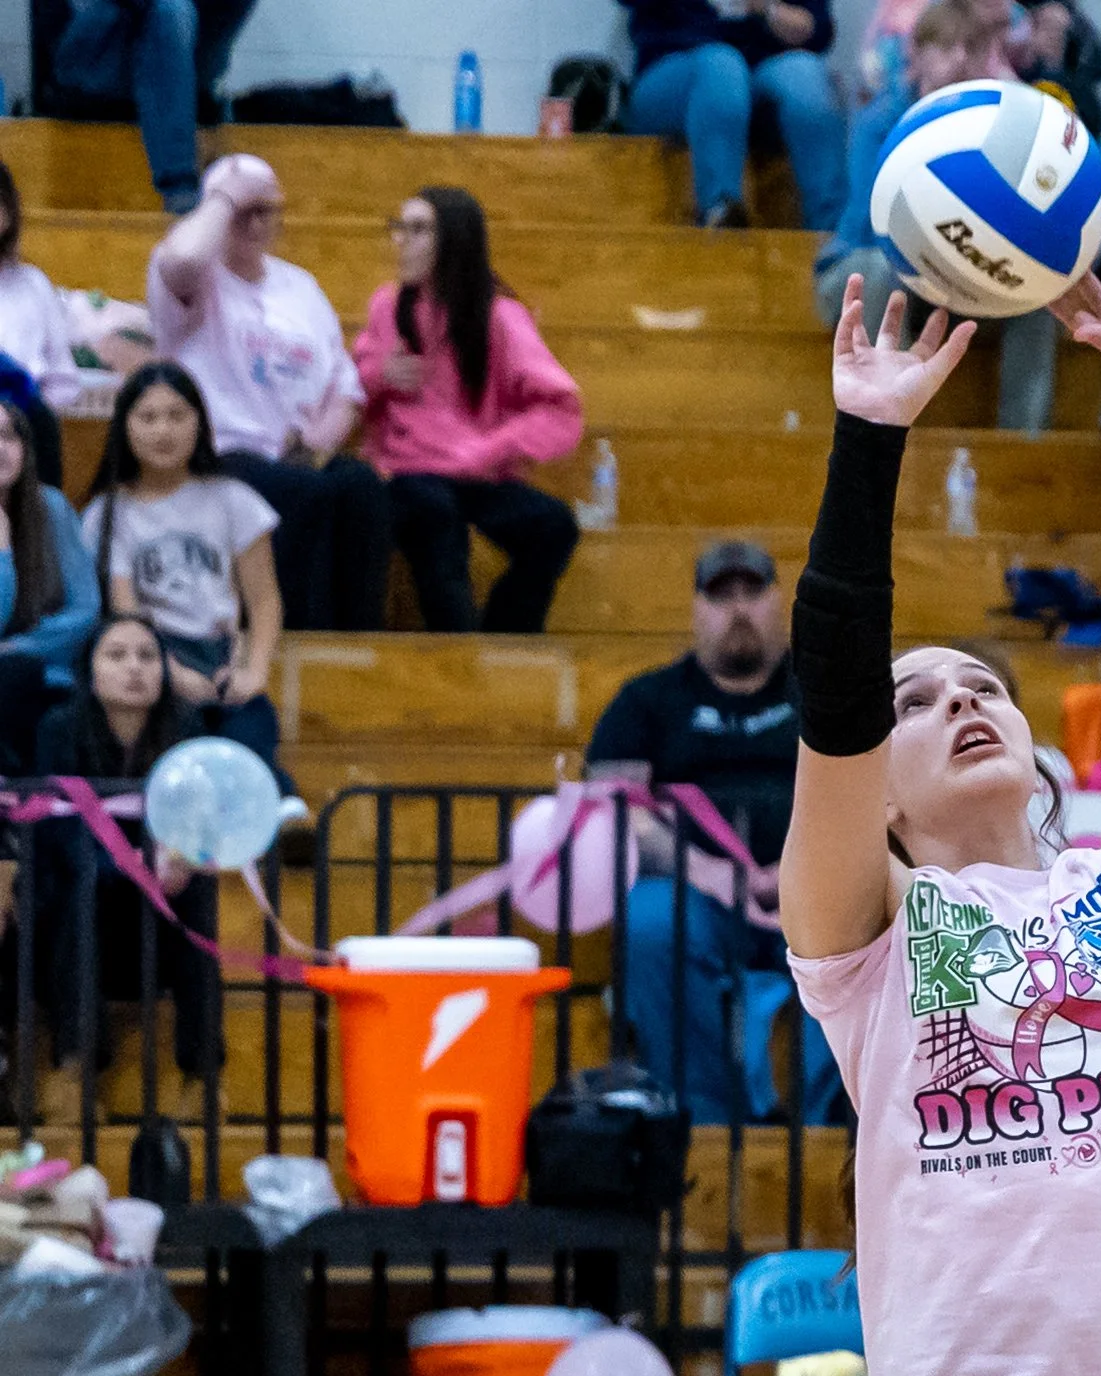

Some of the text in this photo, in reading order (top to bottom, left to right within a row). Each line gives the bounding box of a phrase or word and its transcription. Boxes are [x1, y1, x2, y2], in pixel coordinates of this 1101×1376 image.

[1013, 916, 1050, 948] VS
[920, 944, 931, 1005] CAPTAINS
[1016, 1002, 1051, 1043] Hope
[914, 1081, 1044, 1150] DIG
[920, 1157, 962, 1175] RIVALS
[966, 1155, 981, 1170] ON
[985, 1151, 1008, 1168] THE
